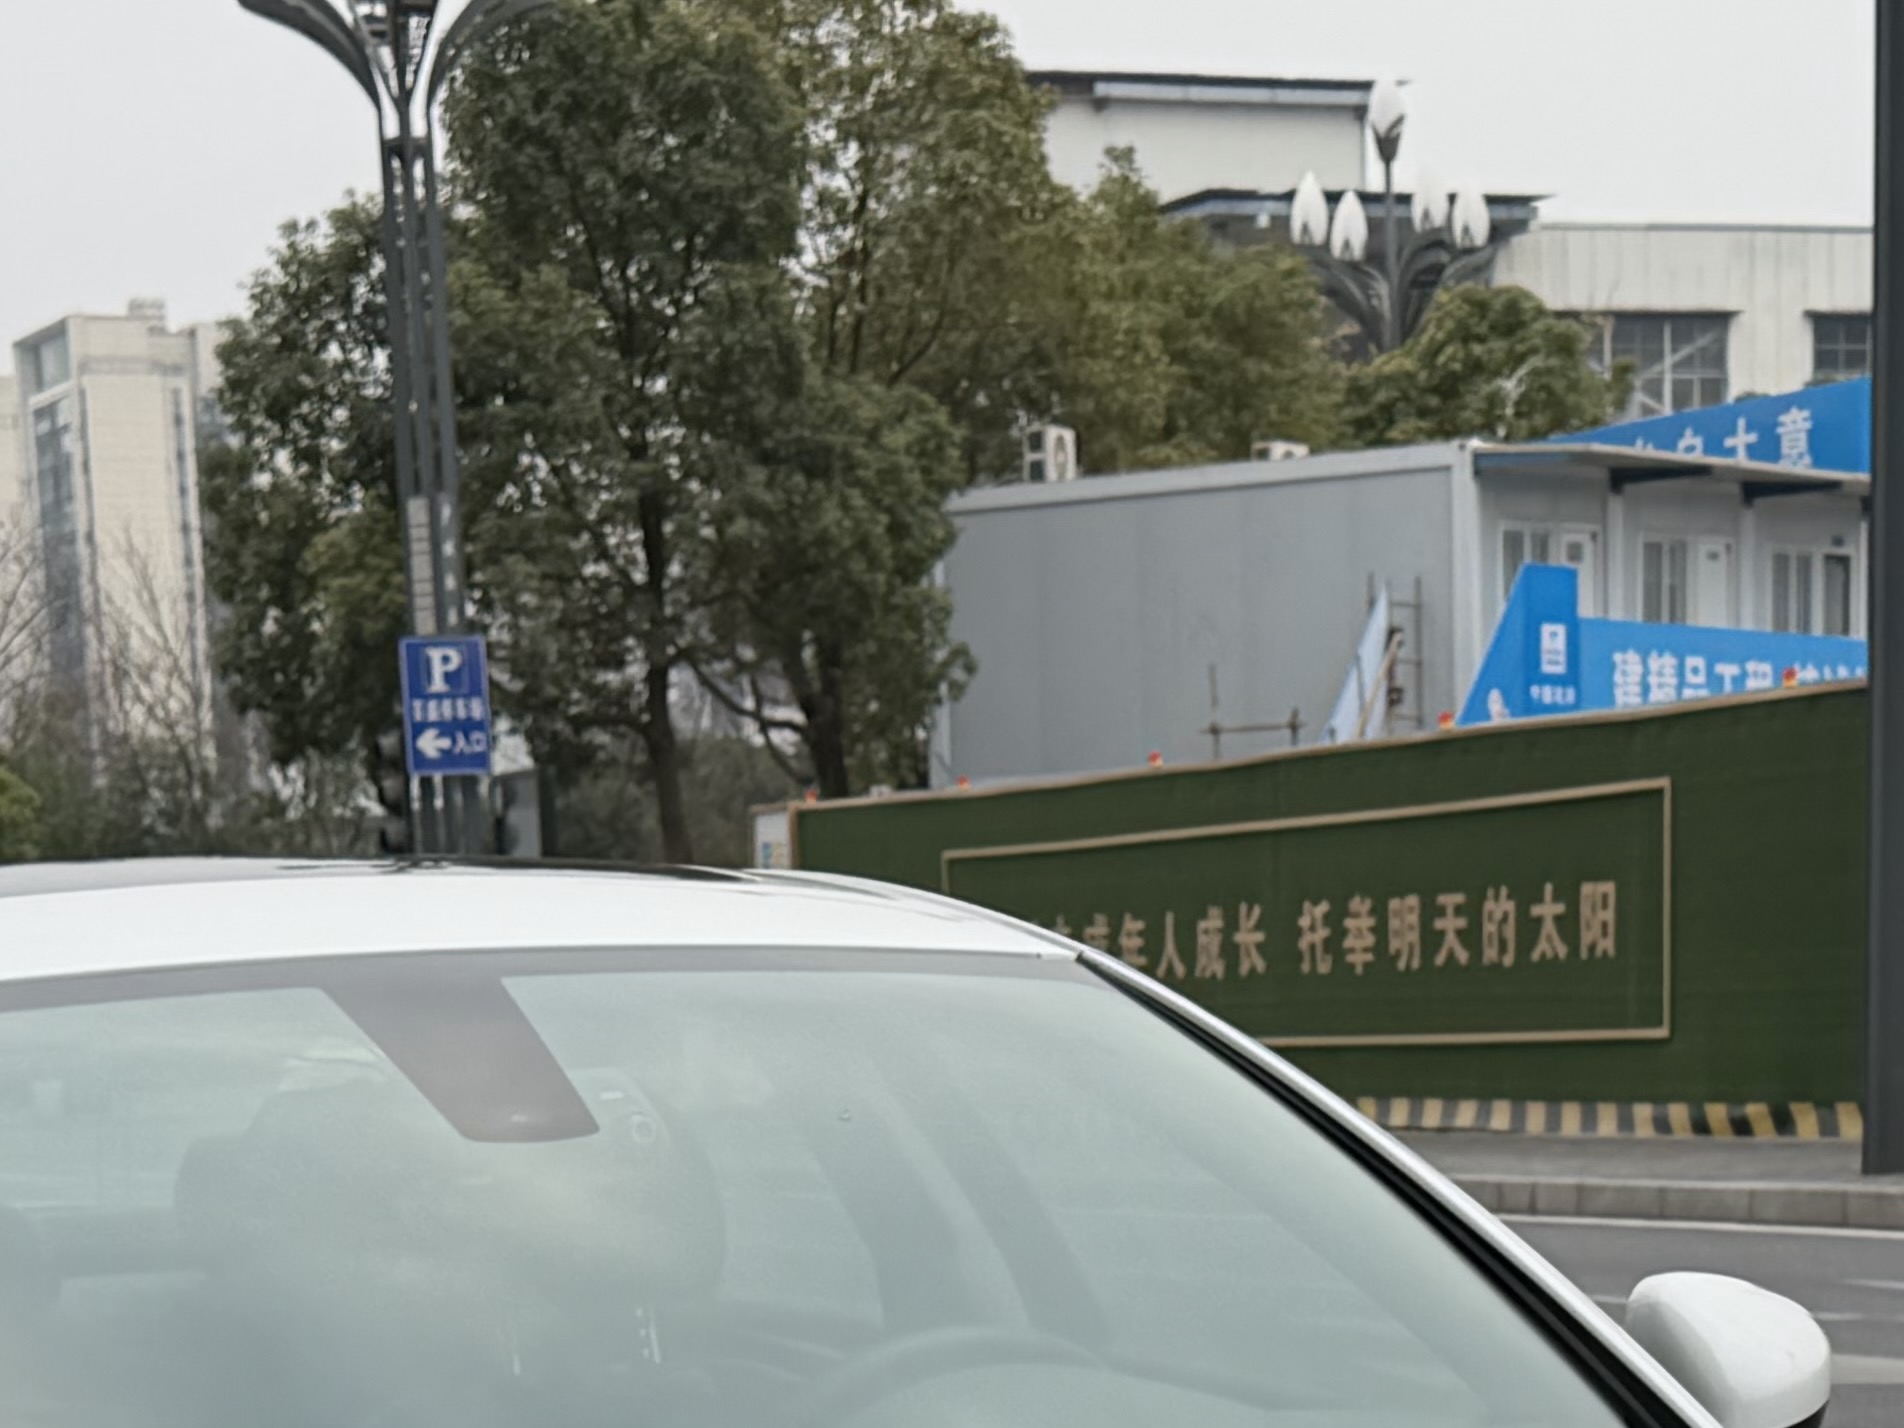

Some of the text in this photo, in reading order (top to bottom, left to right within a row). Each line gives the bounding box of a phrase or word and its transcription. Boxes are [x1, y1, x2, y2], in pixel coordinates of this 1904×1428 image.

[425, 645, 463, 694] P
[1298, 881, 1616, 975] 托举明天的太阳
